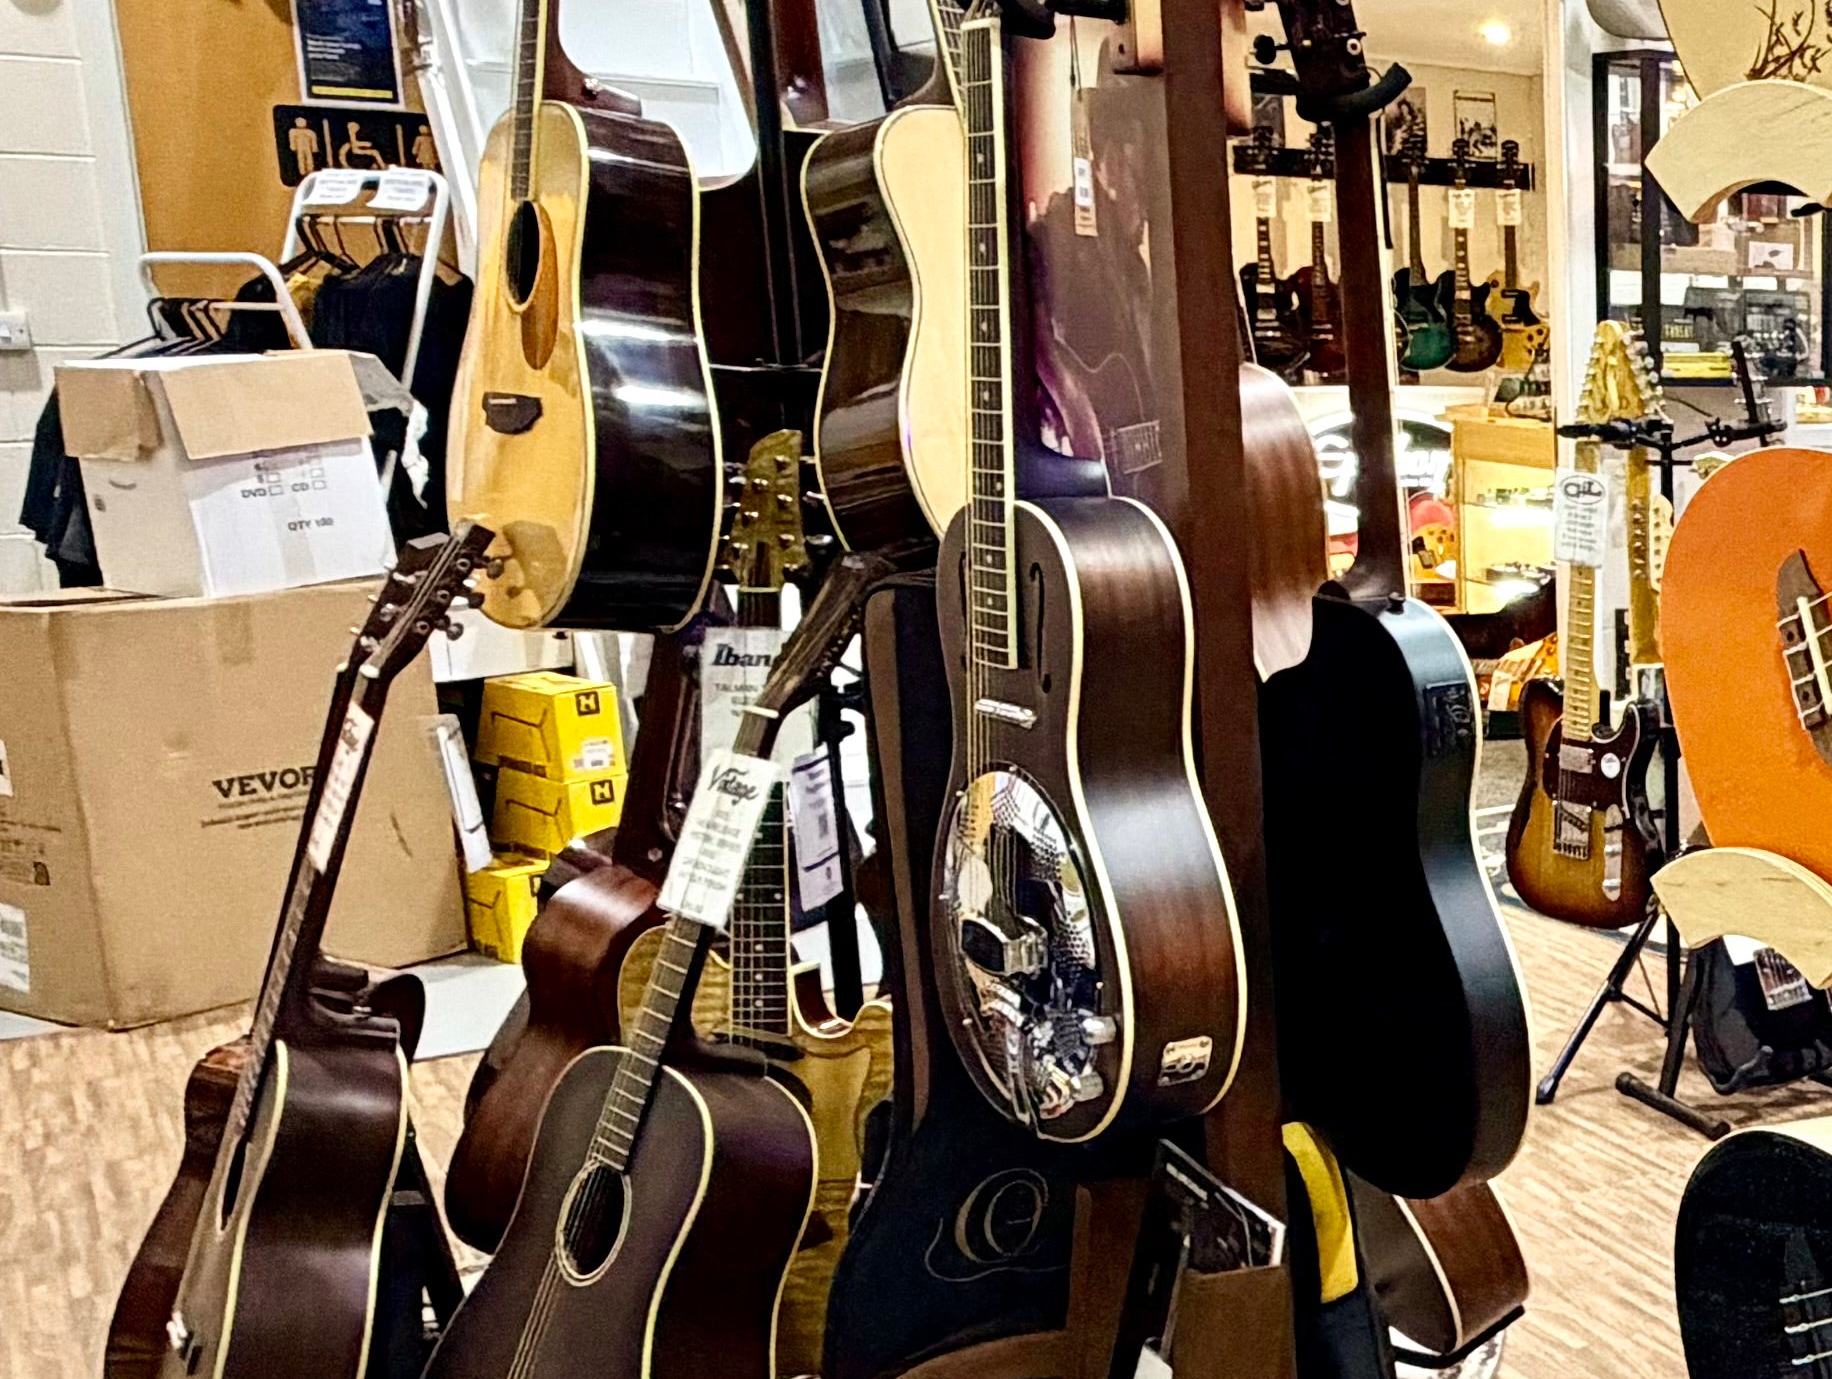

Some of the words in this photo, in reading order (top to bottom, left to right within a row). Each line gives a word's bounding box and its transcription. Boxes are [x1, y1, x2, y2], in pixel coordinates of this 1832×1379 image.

[240, 488, 268, 499] DVD
[287, 520, 312, 532] QTY
[712, 642, 772, 668] Iban
[707, 765, 761, 806] Vintage
